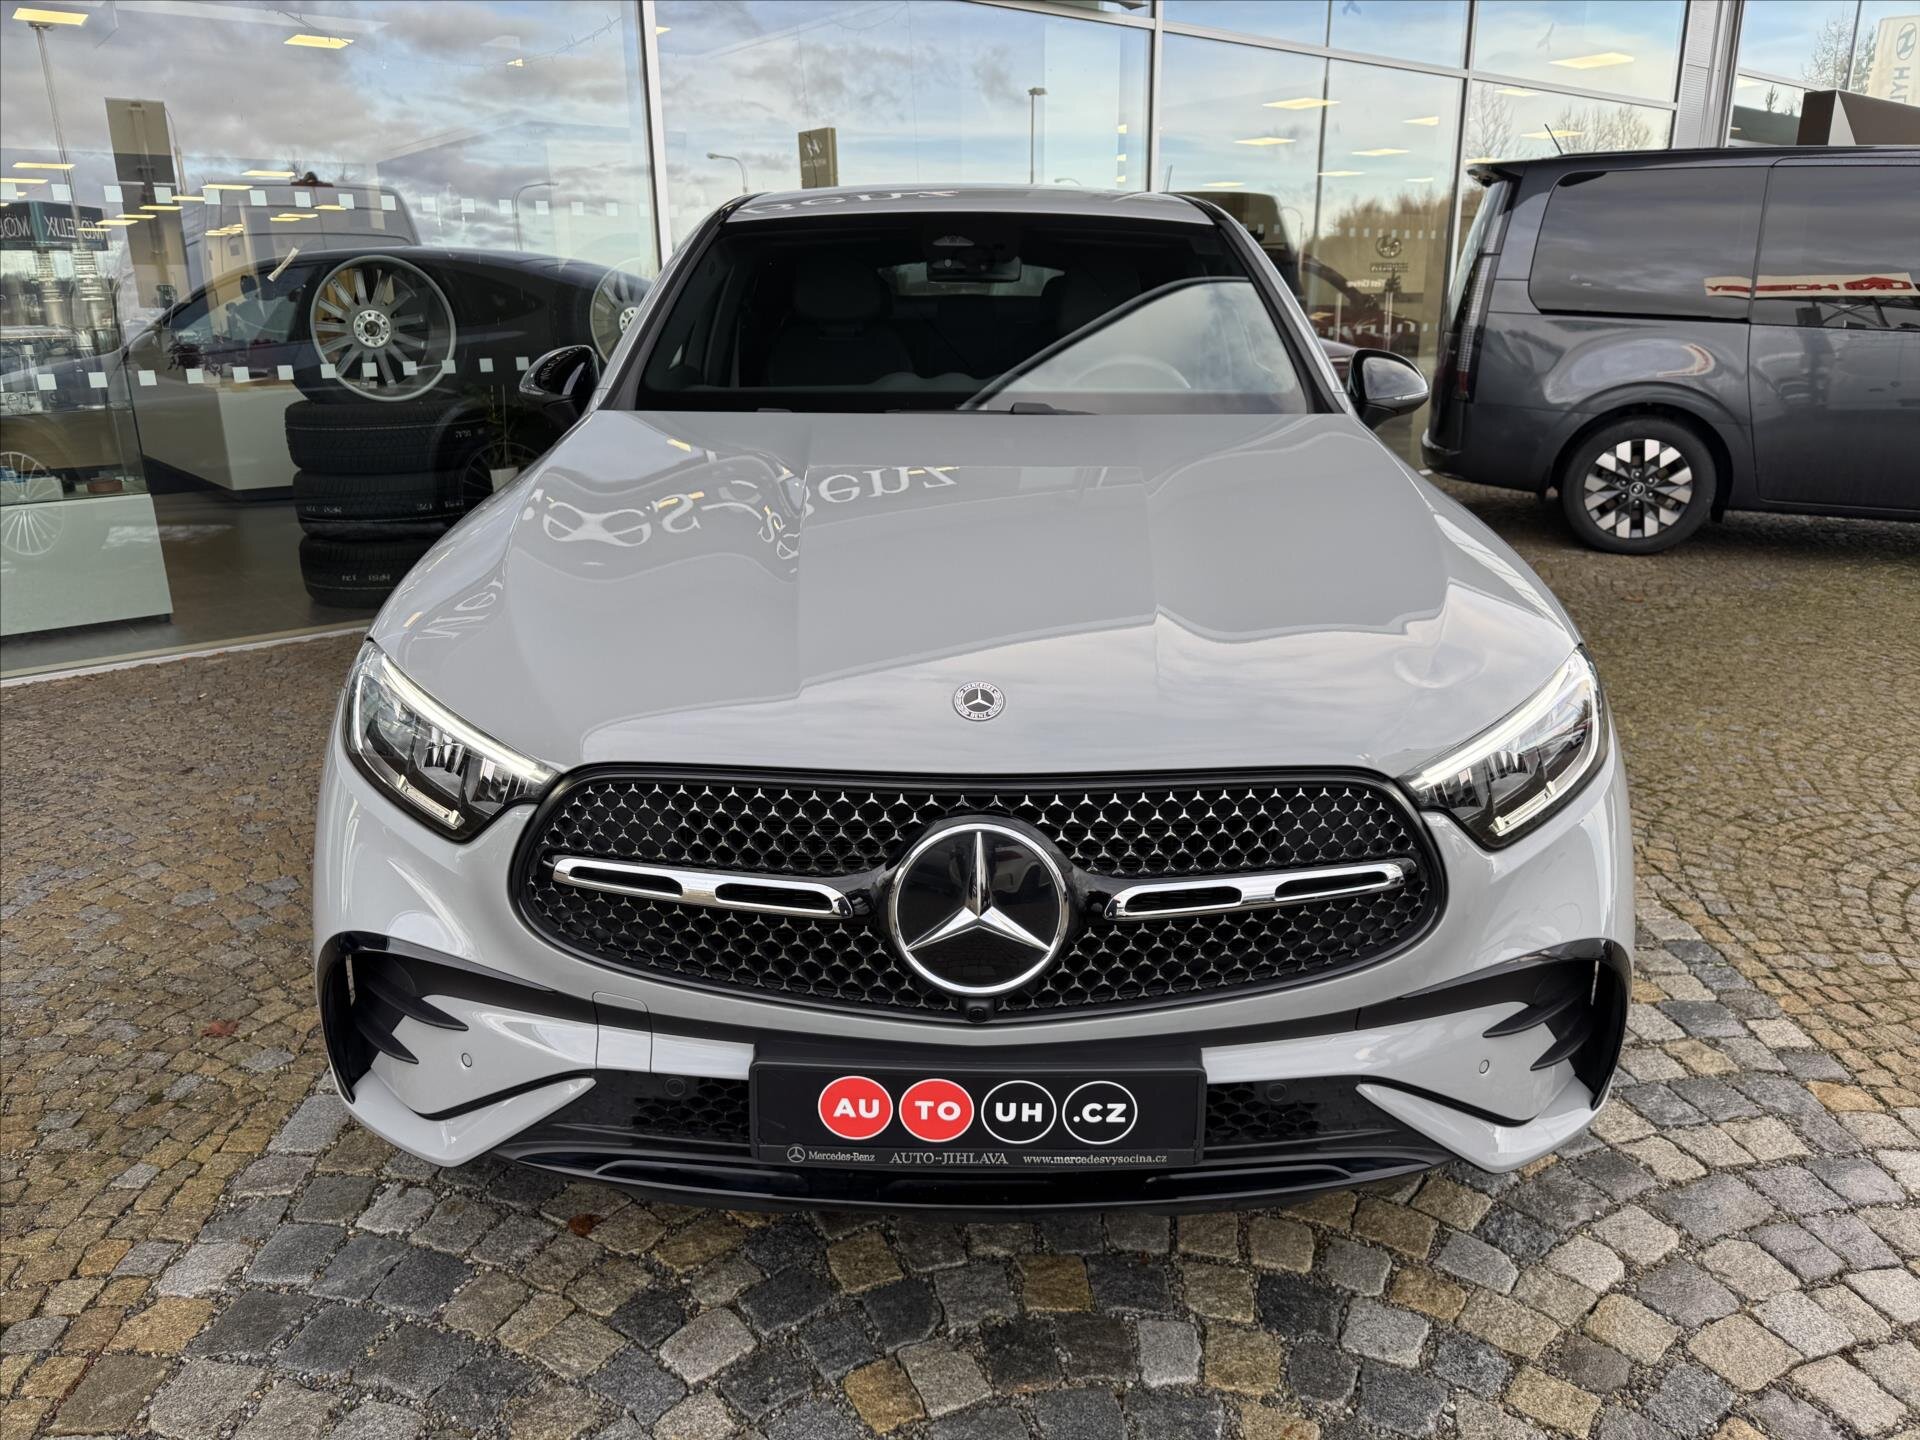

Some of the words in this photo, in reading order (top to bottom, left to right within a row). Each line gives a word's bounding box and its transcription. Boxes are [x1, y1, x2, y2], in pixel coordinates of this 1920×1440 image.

[833, 1097, 880, 1119] AU
[914, 1100, 961, 1121] TO
[995, 1102, 1043, 1122] UH
[1073, 1103, 1127, 1123] .CZ
[808, 1150, 875, 1162] Mercedes-Benz
[889, 1152, 1008, 1164] AUTO-JIHLAVA
[1023, 1154, 1168, 1165] www.mercedesvysocina.cz
